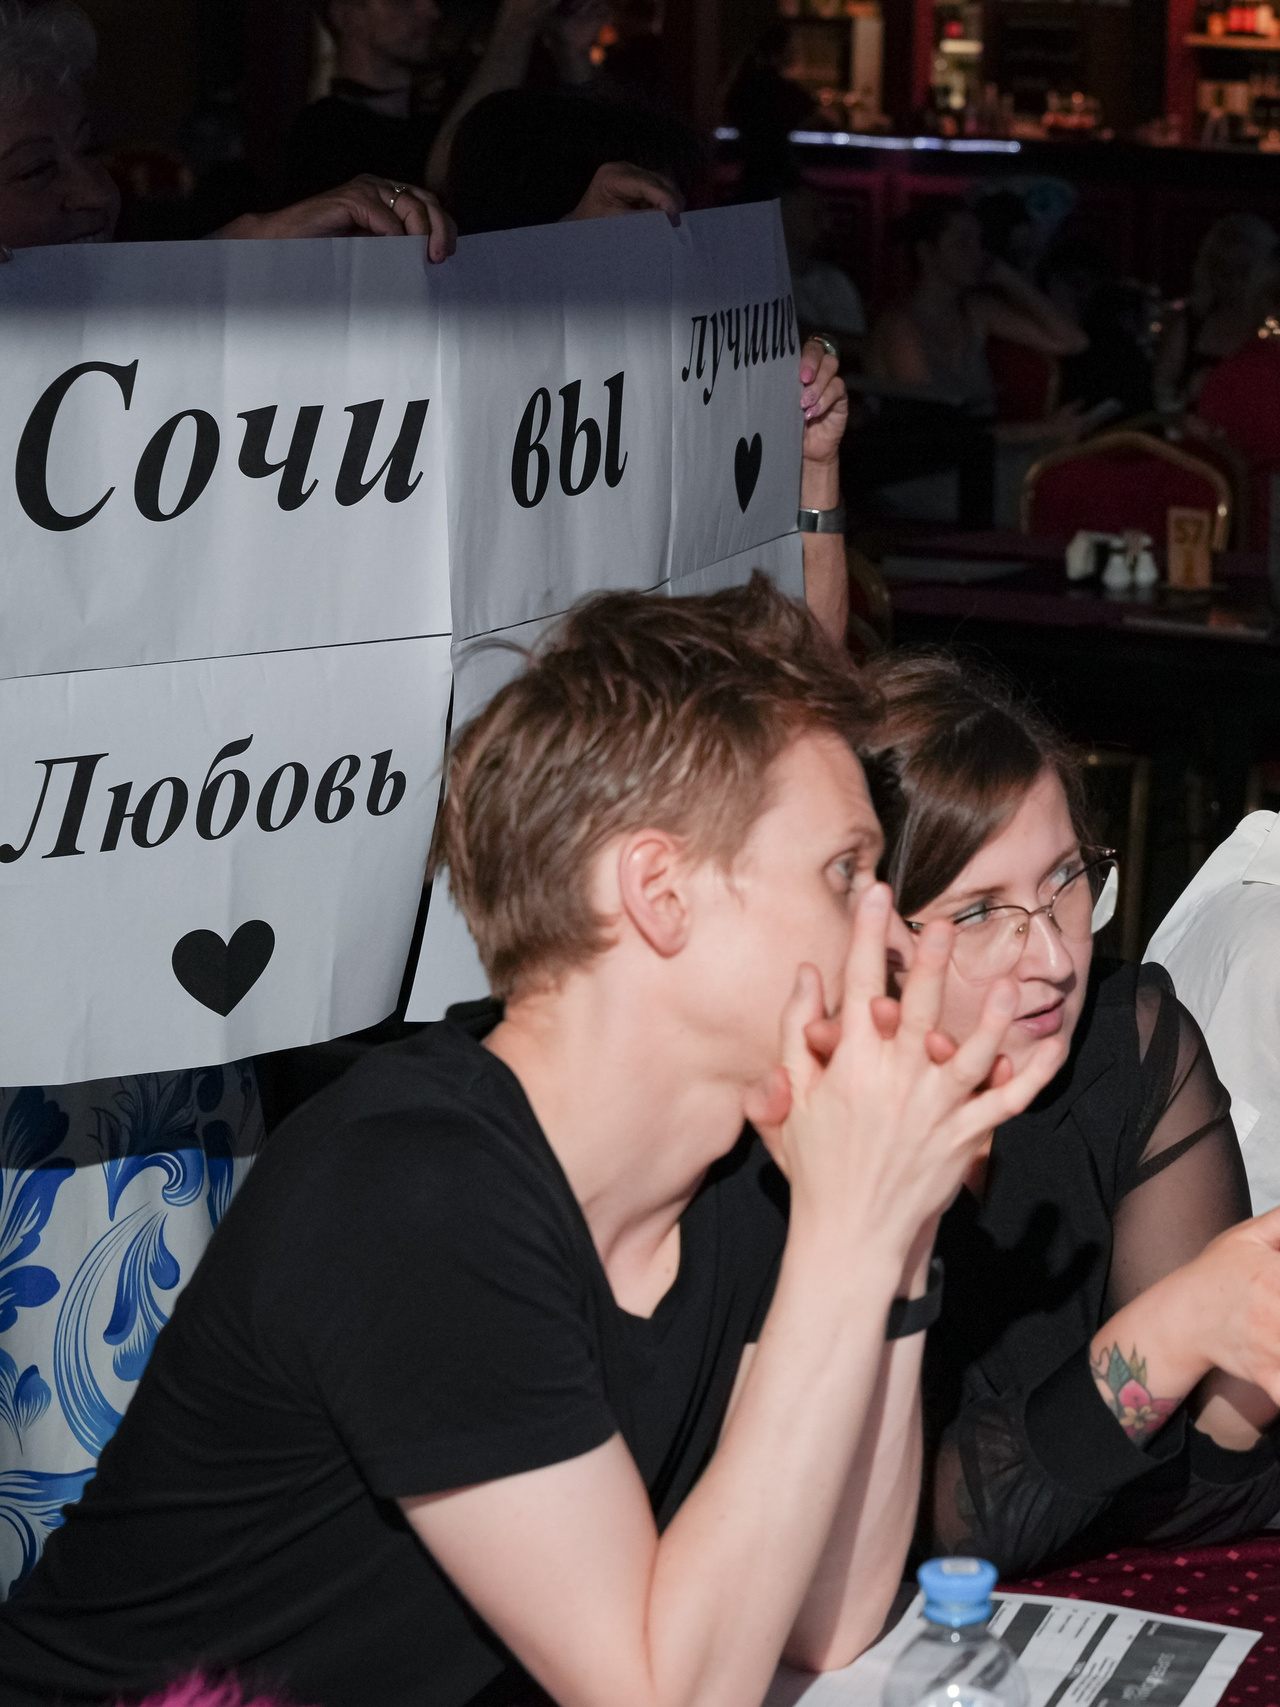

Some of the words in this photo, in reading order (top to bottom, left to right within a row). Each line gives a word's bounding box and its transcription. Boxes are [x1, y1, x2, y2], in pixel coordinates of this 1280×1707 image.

[15, 359, 430, 532] Сочи
[511, 371, 629, 508] вы
[681, 294, 797, 405] лучшие
[0, 733, 406, 863] Любовь
